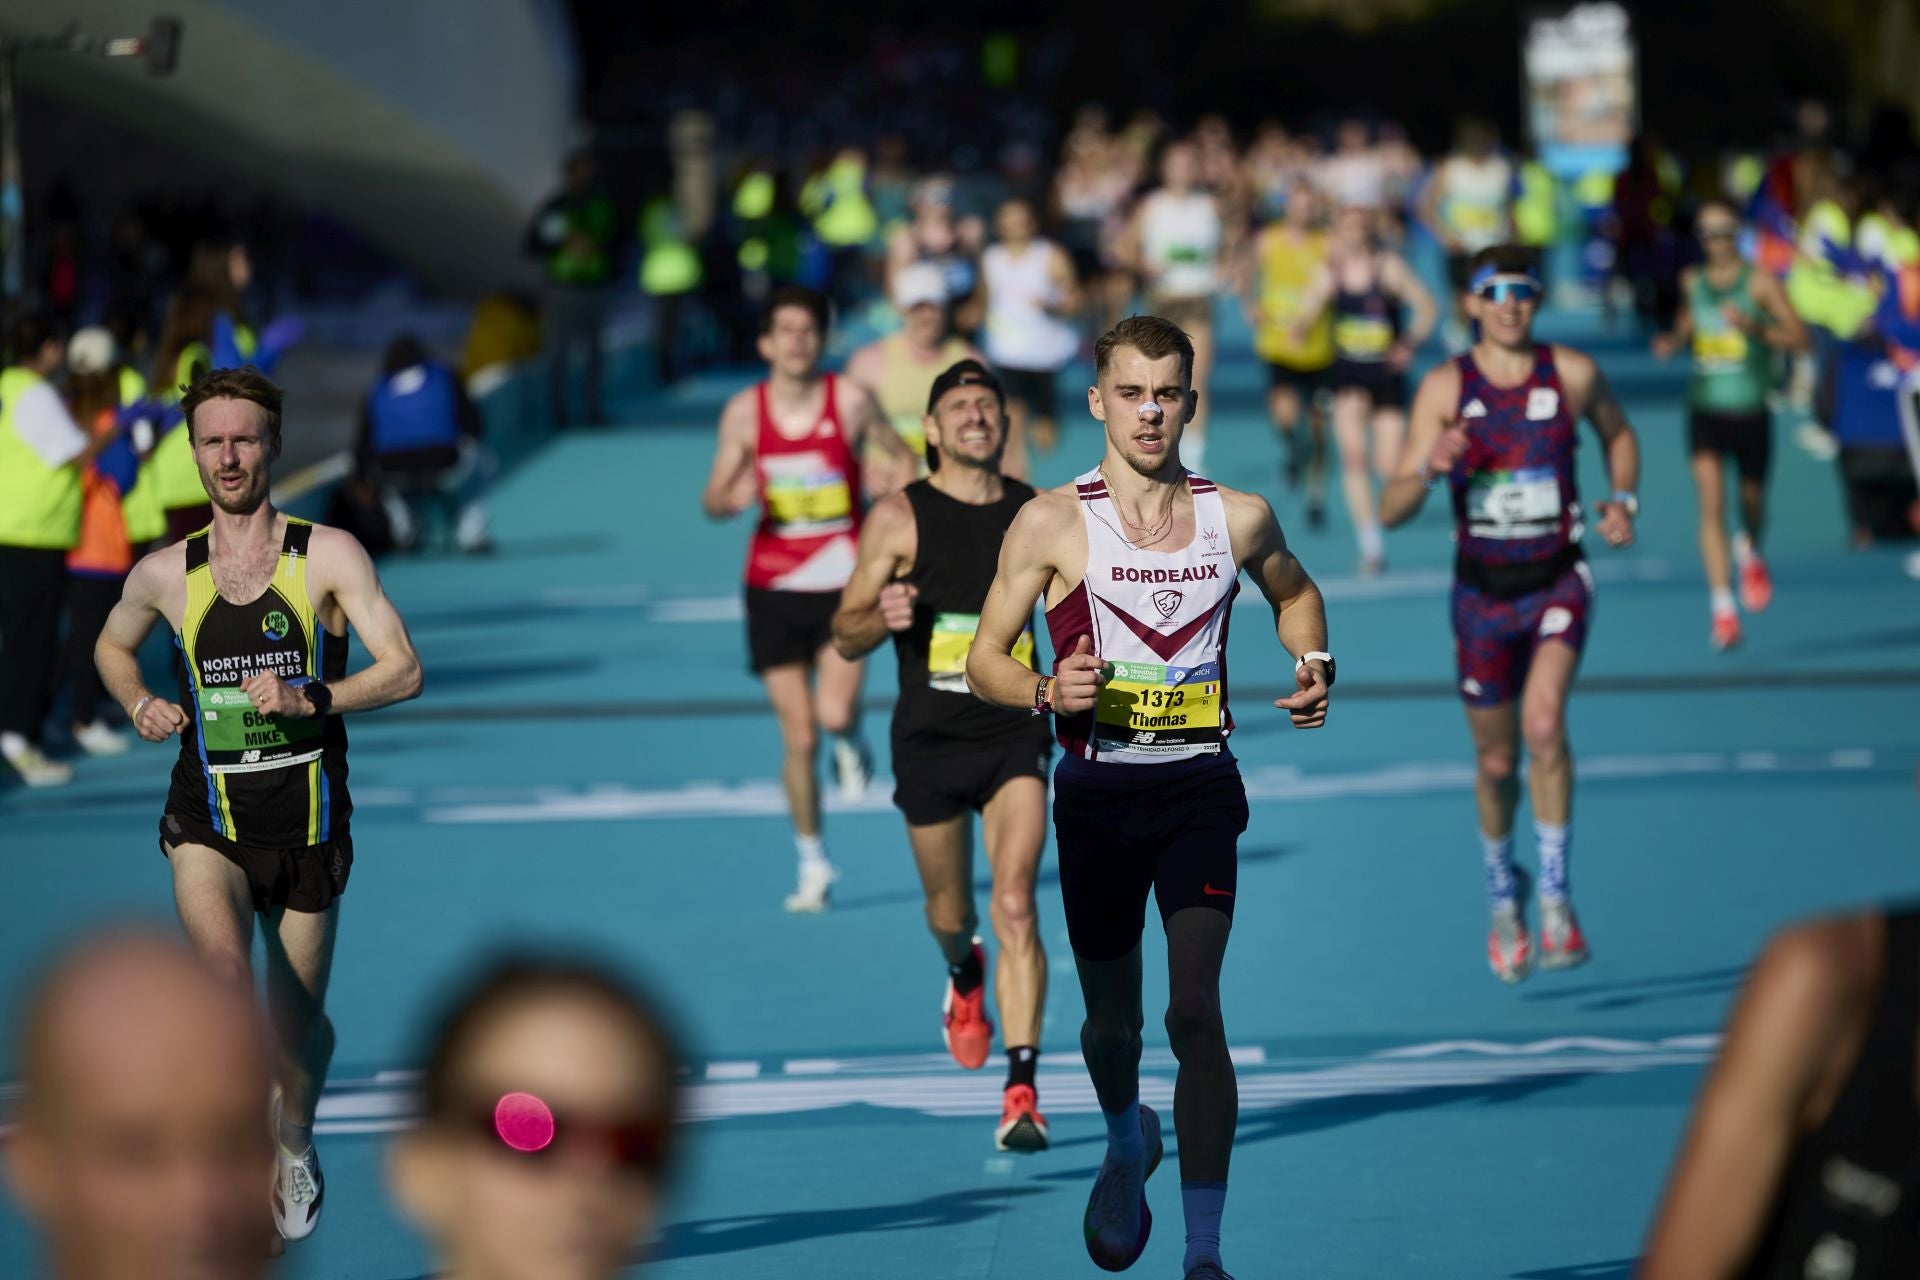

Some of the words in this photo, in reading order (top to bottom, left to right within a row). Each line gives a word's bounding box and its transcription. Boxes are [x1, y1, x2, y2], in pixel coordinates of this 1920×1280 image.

[1111, 563, 1220, 583] BORDEAUX
[202, 655, 252, 672] NORTH
[255, 650, 301, 667] HERTS
[204, 672, 238, 684] ROAD
[1130, 668, 1158, 676] TRINIDAD
[1140, 689, 1185, 708] 1373
[1131, 711, 1187, 727] Thomas
[244, 730, 282, 746] MIKE
[272, 752, 292, 760] balance
